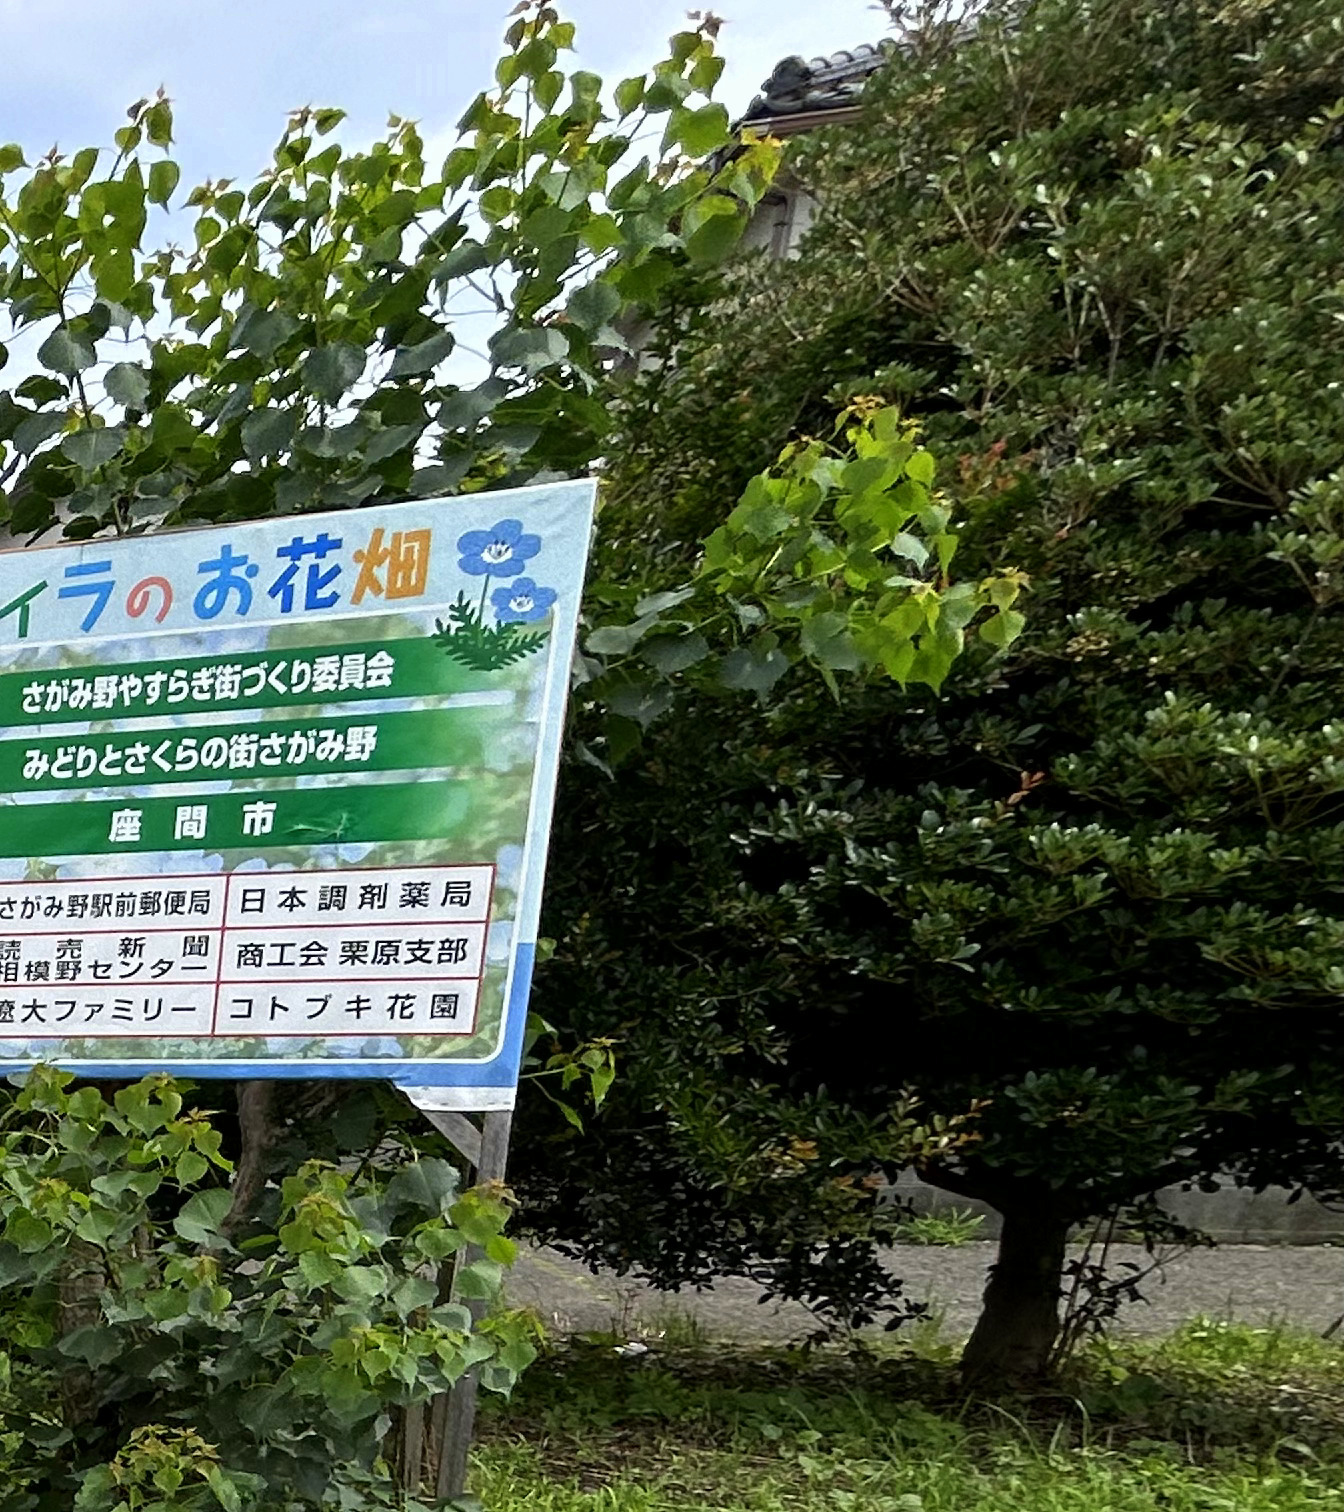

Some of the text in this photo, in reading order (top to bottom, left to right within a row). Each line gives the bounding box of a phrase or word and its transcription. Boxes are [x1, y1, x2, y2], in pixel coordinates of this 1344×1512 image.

[21, 651, 395, 714] さがみ野やすらぎ街づくり委員会
[22, 725, 378, 780] みどりとさくらの街さがみ野
[108, 801, 277, 842] 座間市
[240, 881, 472, 913] 日本調剤薬局
[236, 937, 468, 969] 商工会 栗原支部
[230, 993, 459, 1021] コトブキ花園
